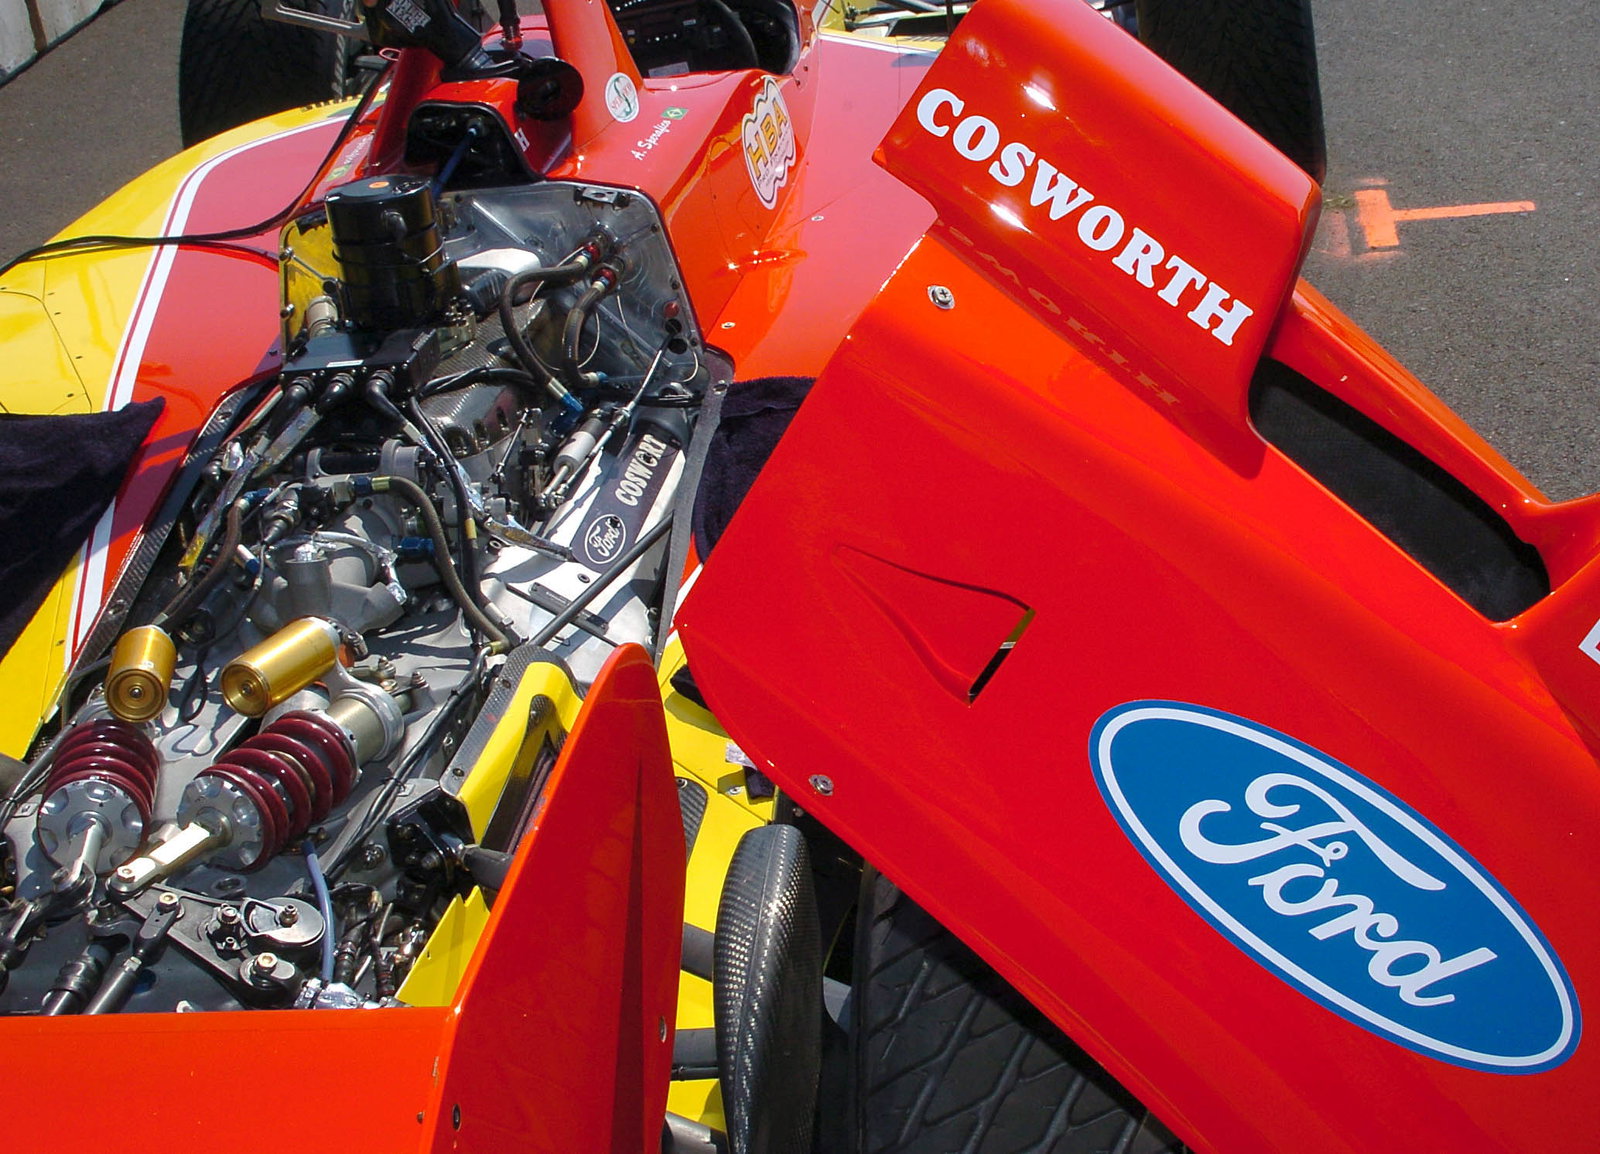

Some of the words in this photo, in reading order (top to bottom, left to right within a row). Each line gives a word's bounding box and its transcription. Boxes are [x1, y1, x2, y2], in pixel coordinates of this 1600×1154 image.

[746, 97, 788, 180] HBA
[917, 88, 1253, 346] COSWORTH
[615, 434, 667, 506] COSWORT
[589, 515, 621, 557] Ford
[1179, 773, 1498, 1007] Ford
